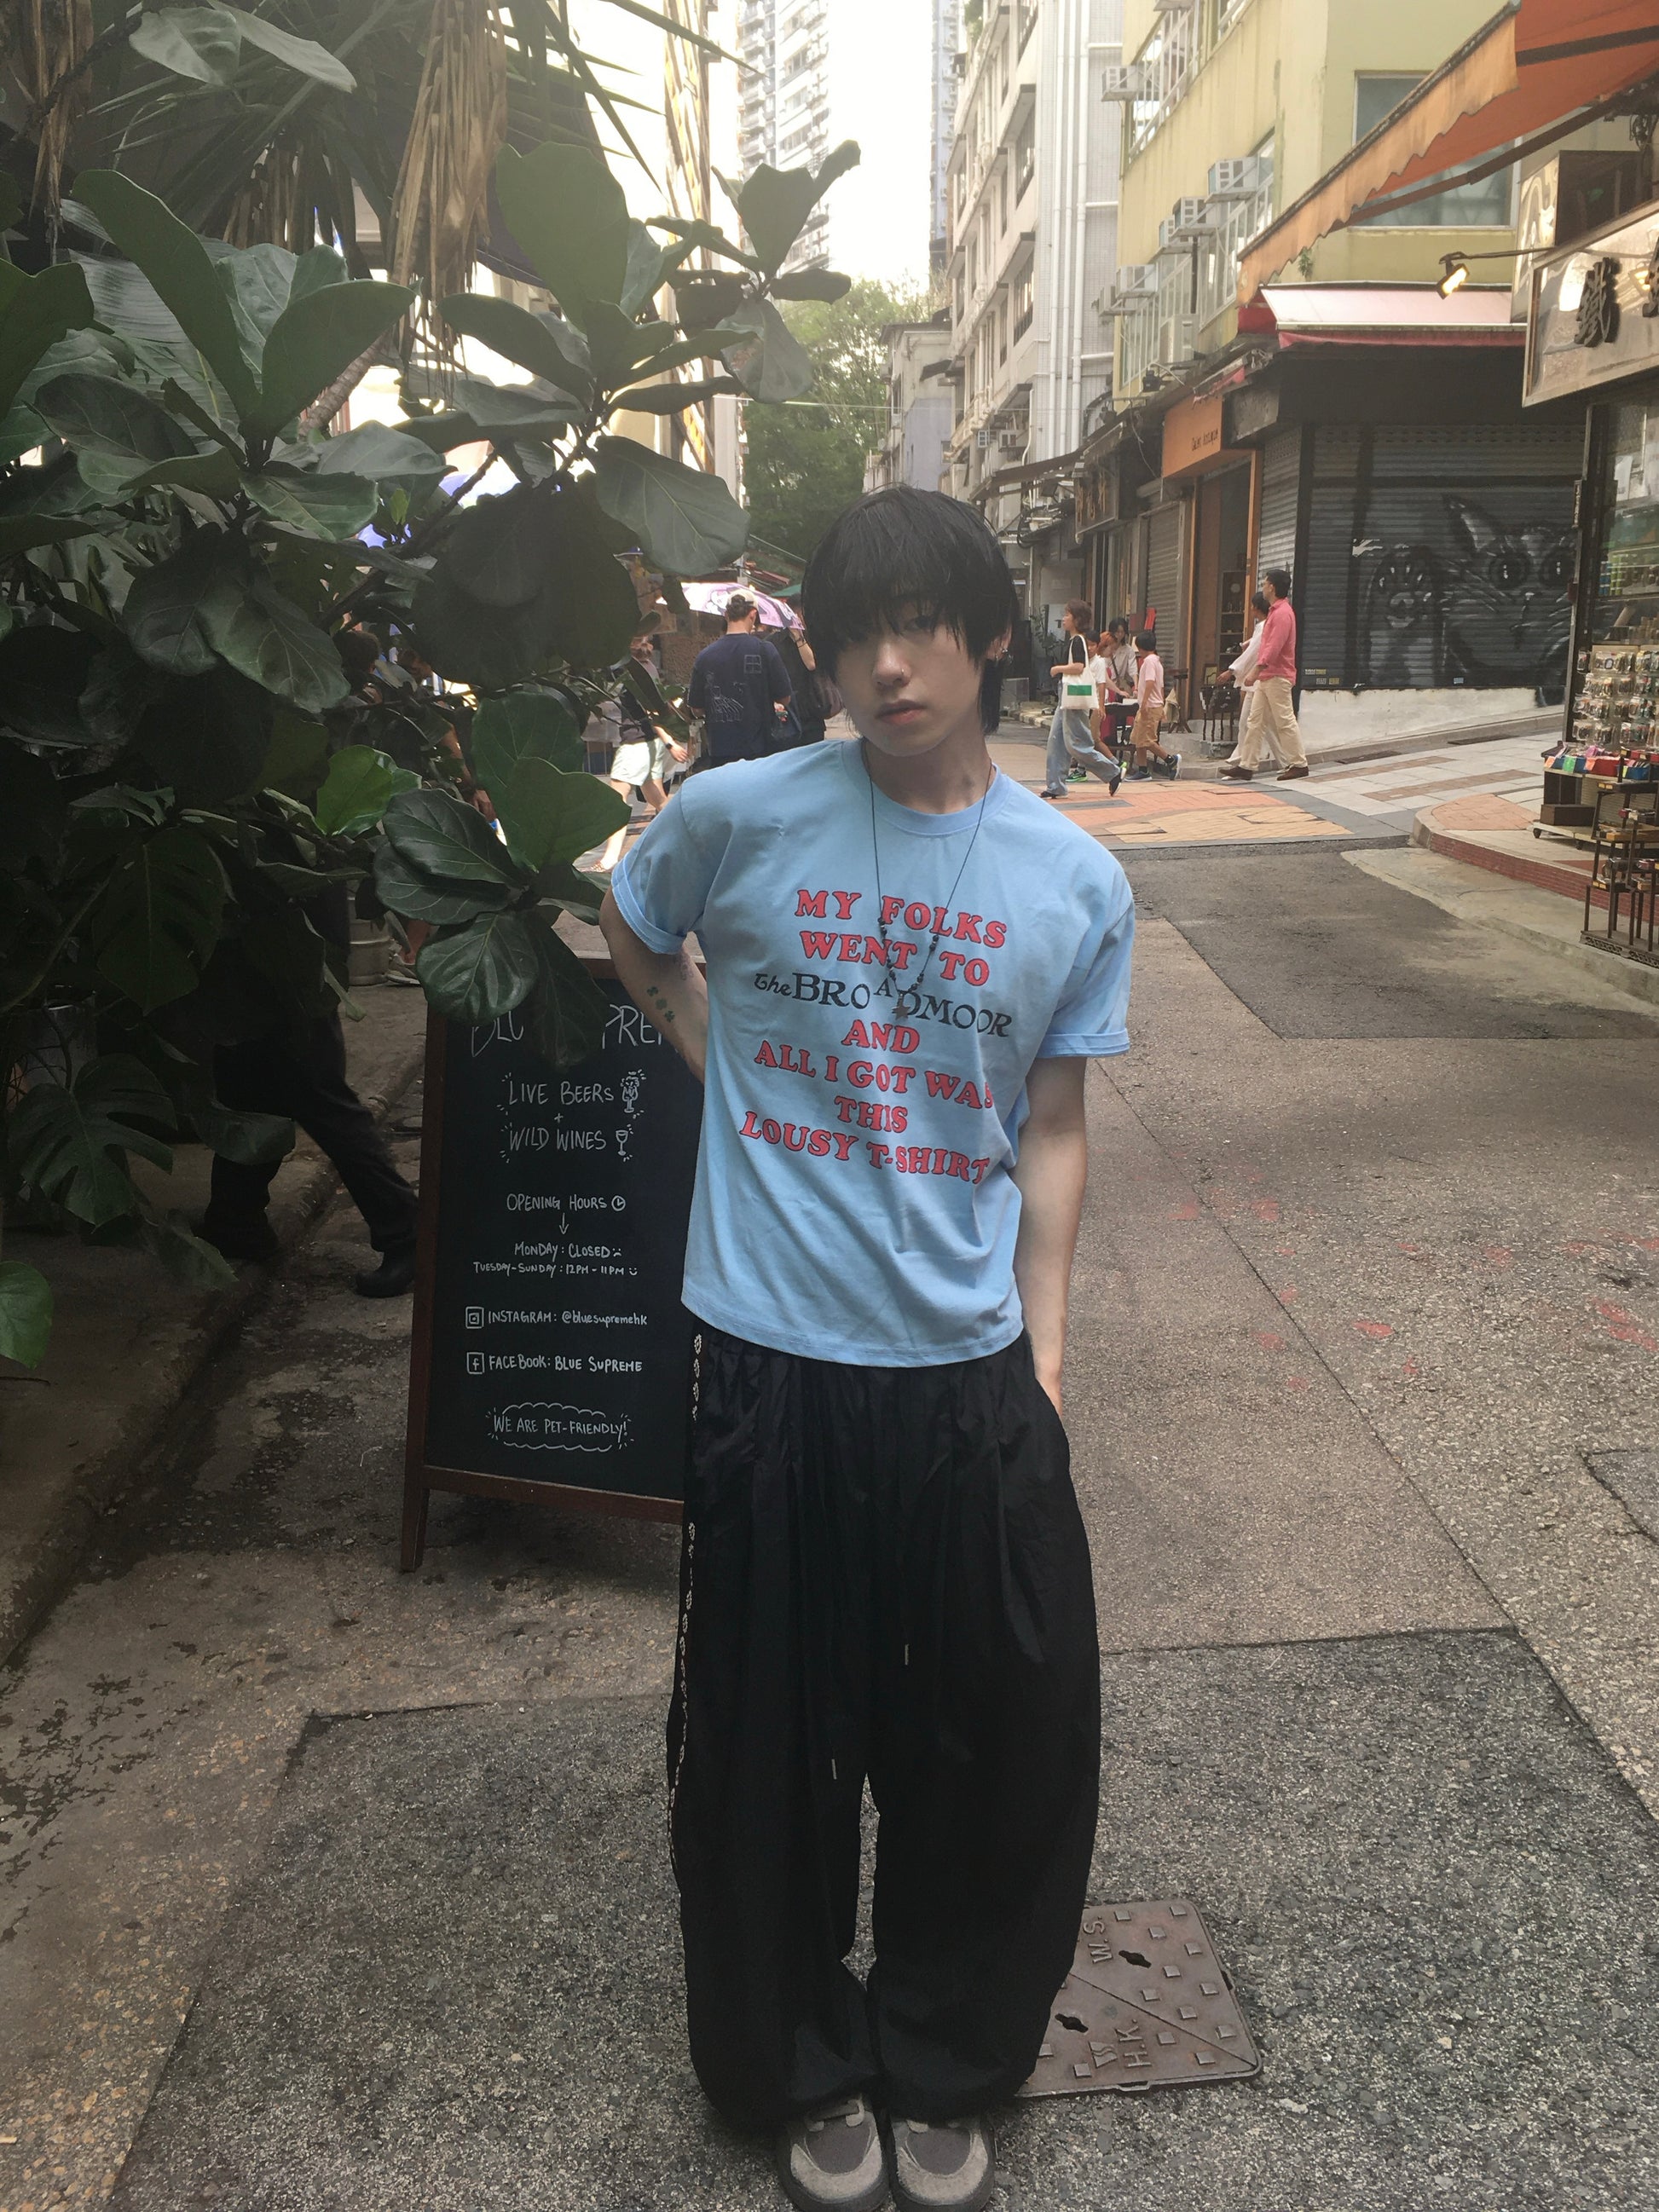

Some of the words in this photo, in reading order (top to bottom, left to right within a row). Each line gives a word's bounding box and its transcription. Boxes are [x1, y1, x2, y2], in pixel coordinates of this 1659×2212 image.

[795, 890, 862, 920] MY
[880, 895, 1007, 948] FOLKS
[800, 931, 917, 970] WENT
[939, 951, 990, 986] TO
[792, 973, 1013, 1037] BROADMOOR
[841, 1019, 920, 1054] AND
[754, 1040, 816, 1078] ALL
[824, 1055, 839, 1083] I
[847, 1060, 916, 1094] GOT
[509, 1080, 549, 1106] LIVE
[560, 1080, 615, 1106] BEERS
[834, 1095, 908, 1134] THIS
[510, 1126, 550, 1151] WILD
[556, 1128, 607, 1152] WINES
[739, 1111, 859, 1161] LOUSY
[866, 1141, 991, 1185] T-SHIRT
[506, 1193, 561, 1211] OPENING
[569, 1193, 608, 1211] HOURS
[568, 1242, 611, 1258] CLOSED
[488, 1309, 558, 1325] INSTAGRAM:
[554, 1354, 582, 1372] BLUE
[588, 1355, 643, 1373] SUPREME
[493, 1415, 512, 1433] WE
[516, 1417, 539, 1433] ARE
